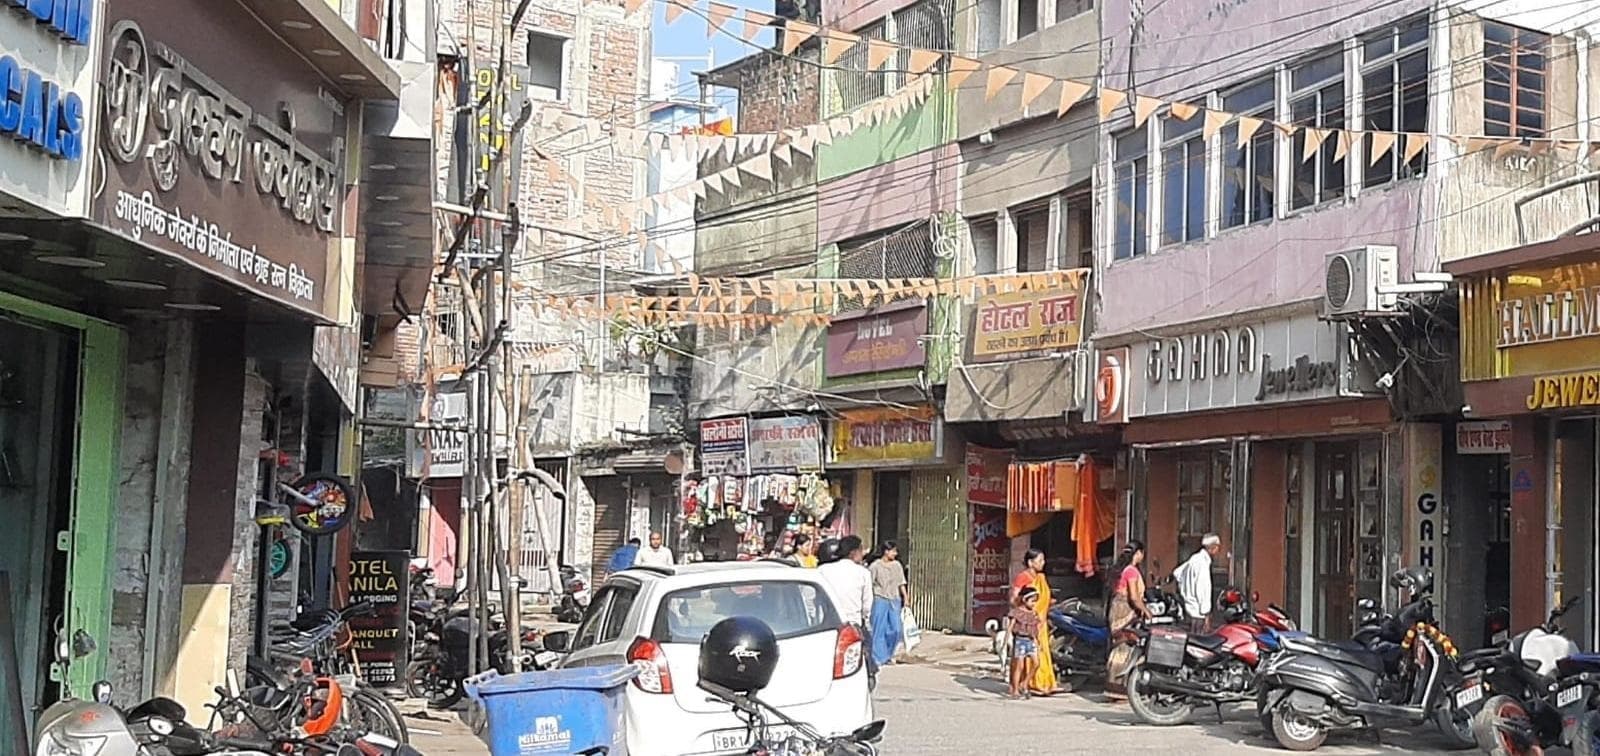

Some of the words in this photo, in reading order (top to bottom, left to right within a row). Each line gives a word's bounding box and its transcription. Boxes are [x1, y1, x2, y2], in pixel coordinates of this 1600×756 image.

[115, 190, 168, 241] आधुनिक
[196, 220, 208, 253] के
[208, 223, 240, 271] निर्माता
[240, 245, 256, 275] एवं
[271, 262, 288, 290] रत्न
[288, 263, 315, 301] विक्रेता
[981, 297, 1033, 334] होटल
[1038, 292, 1078, 327] राज
[352, 628, 399, 639] ANQUET
[352, 640, 375, 650] ALL
[519, 730, 571, 745] Nilkamal
